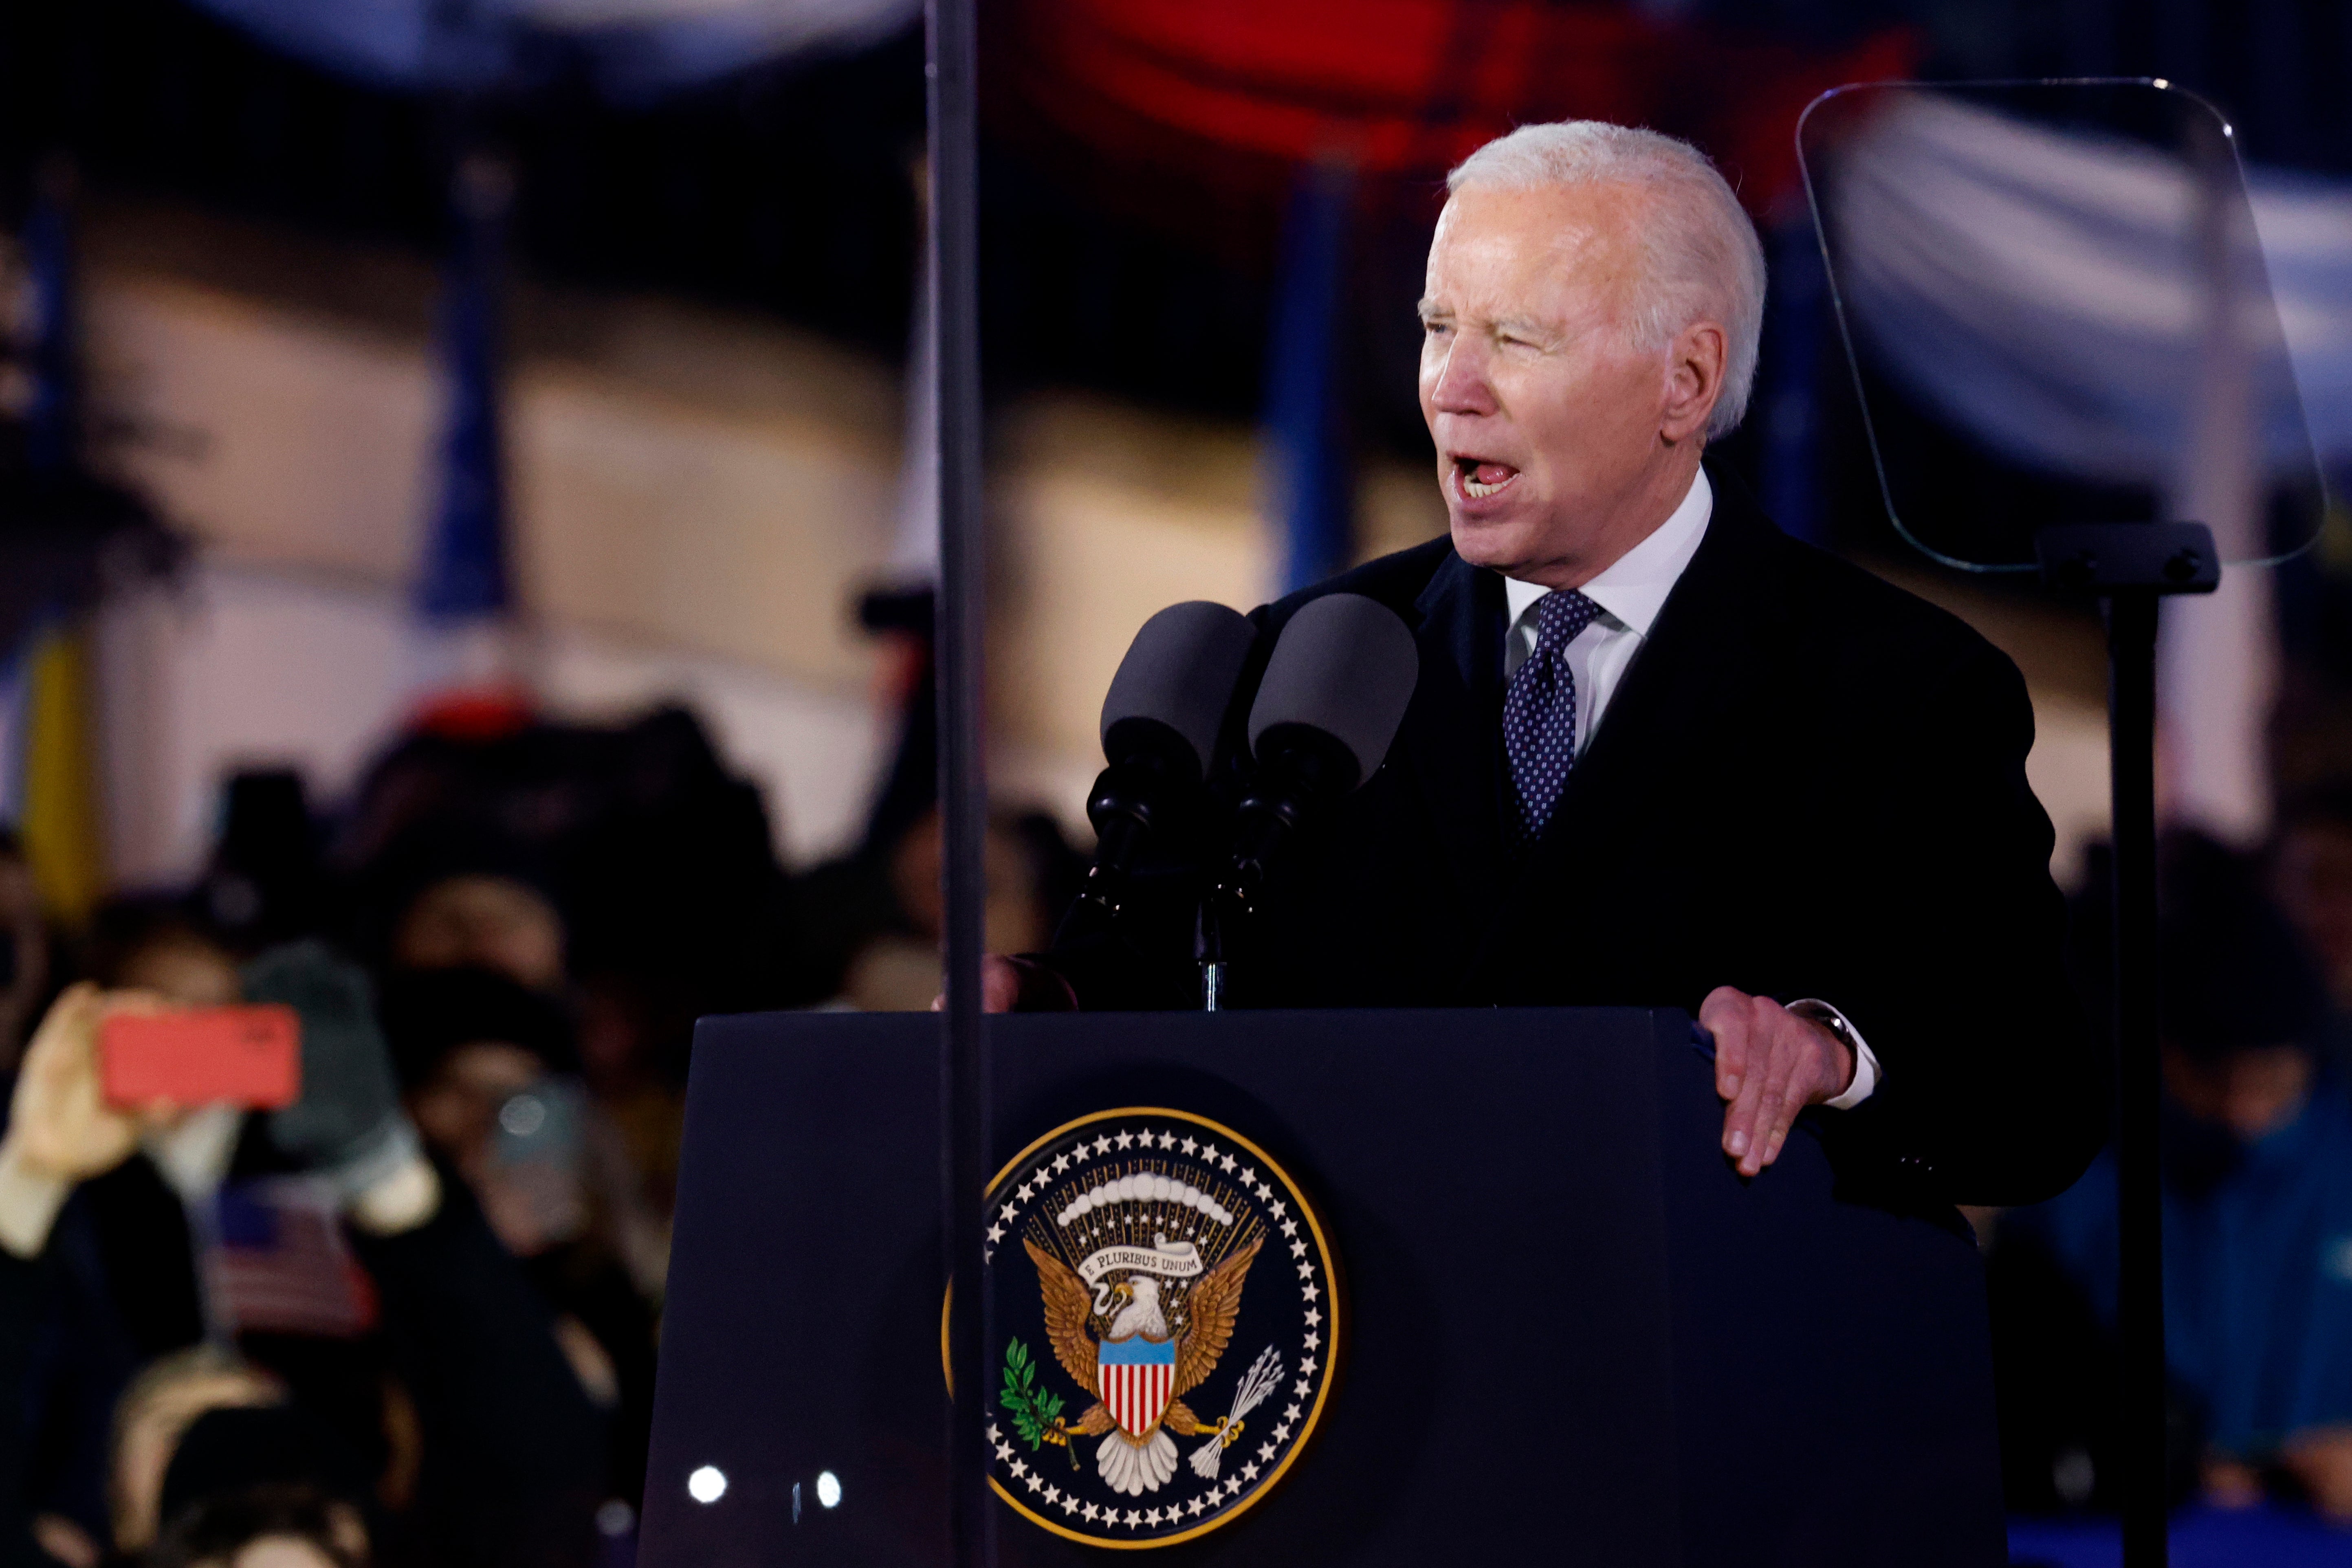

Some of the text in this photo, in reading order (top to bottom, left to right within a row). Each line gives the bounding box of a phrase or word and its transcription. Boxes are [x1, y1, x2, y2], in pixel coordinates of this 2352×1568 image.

[1085, 1252, 1197, 1276] E PLURIBUS UNUM
